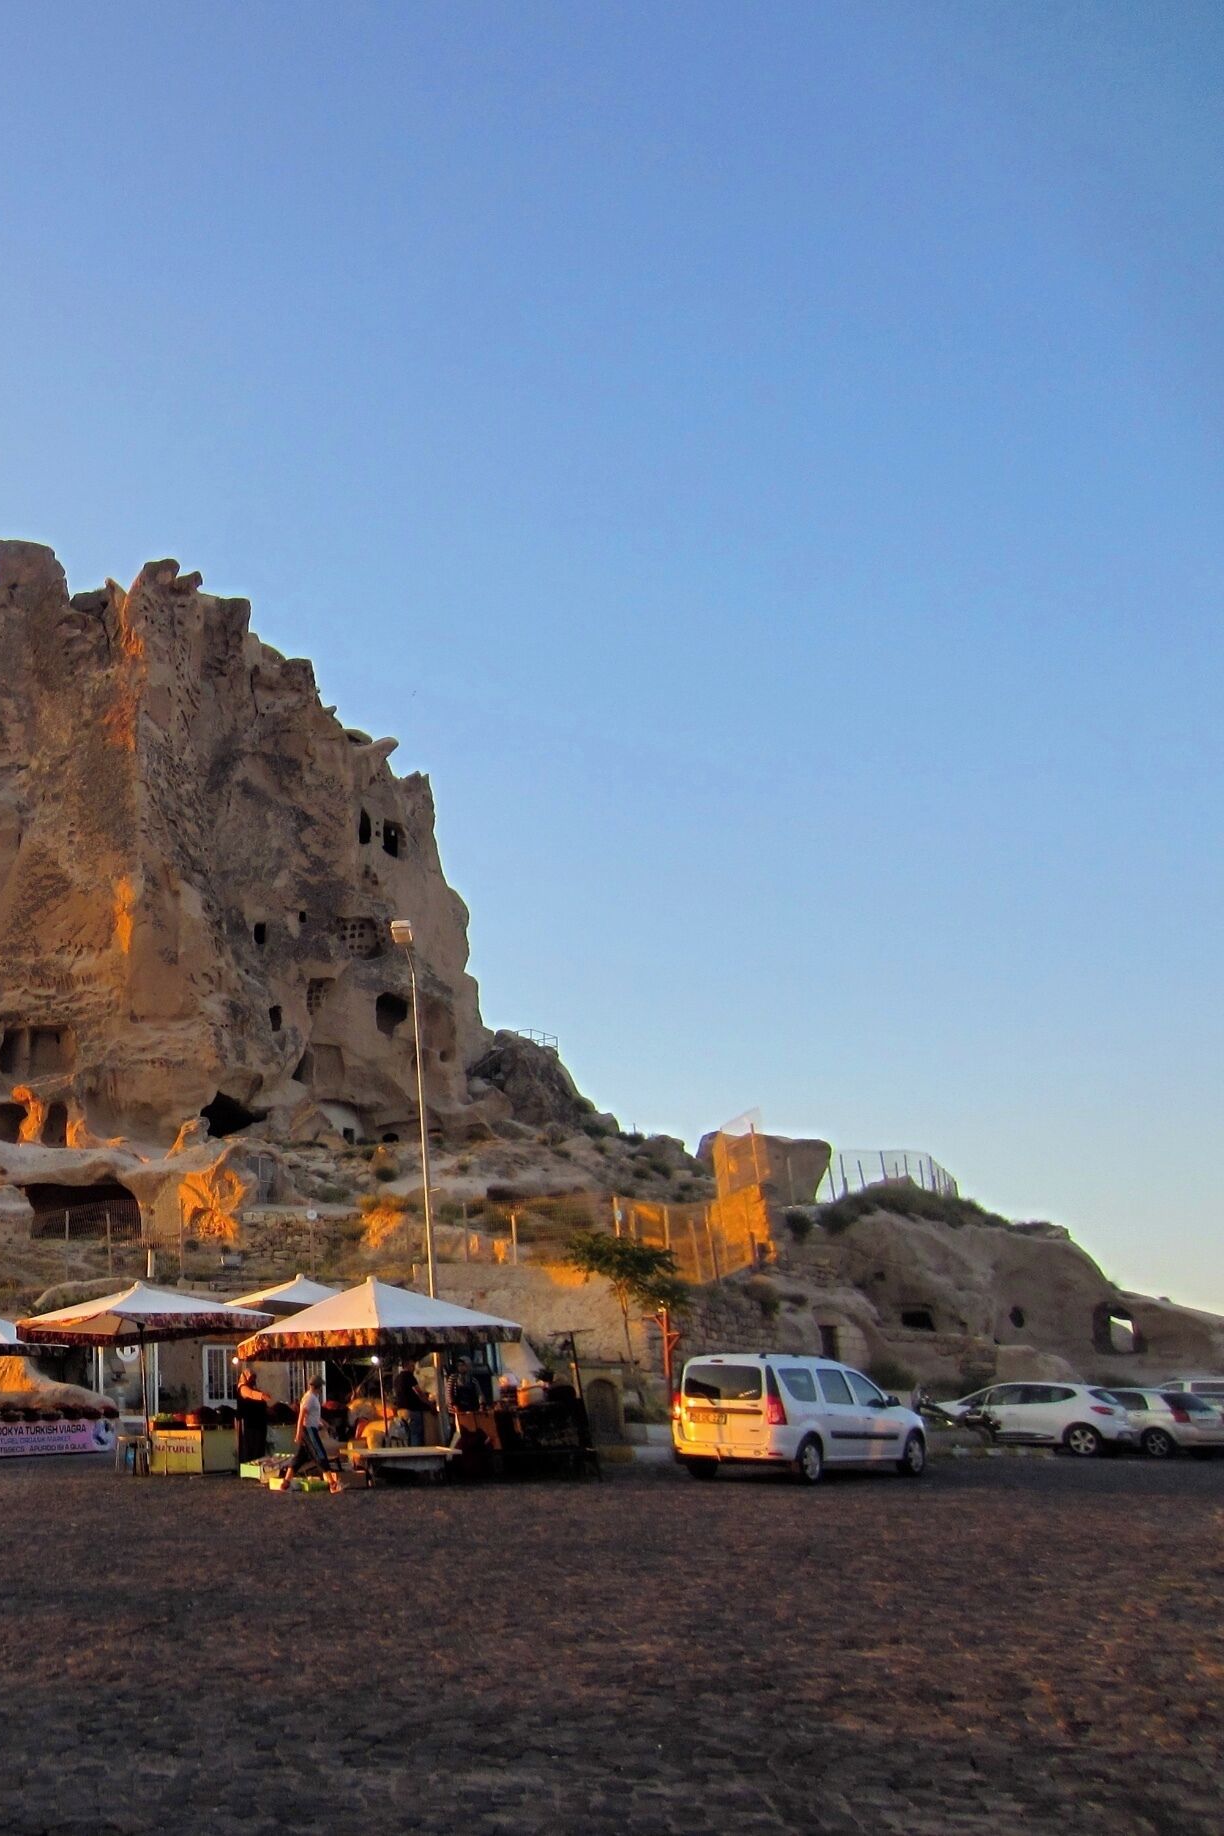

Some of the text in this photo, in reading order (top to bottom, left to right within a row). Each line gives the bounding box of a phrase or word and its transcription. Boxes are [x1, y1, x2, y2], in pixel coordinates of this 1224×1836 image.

[25, 1425, 58, 1435] TURKISH
[59, 1424, 87, 1434] VIAGRA
[154, 1444, 196, 1454] NATUREL
